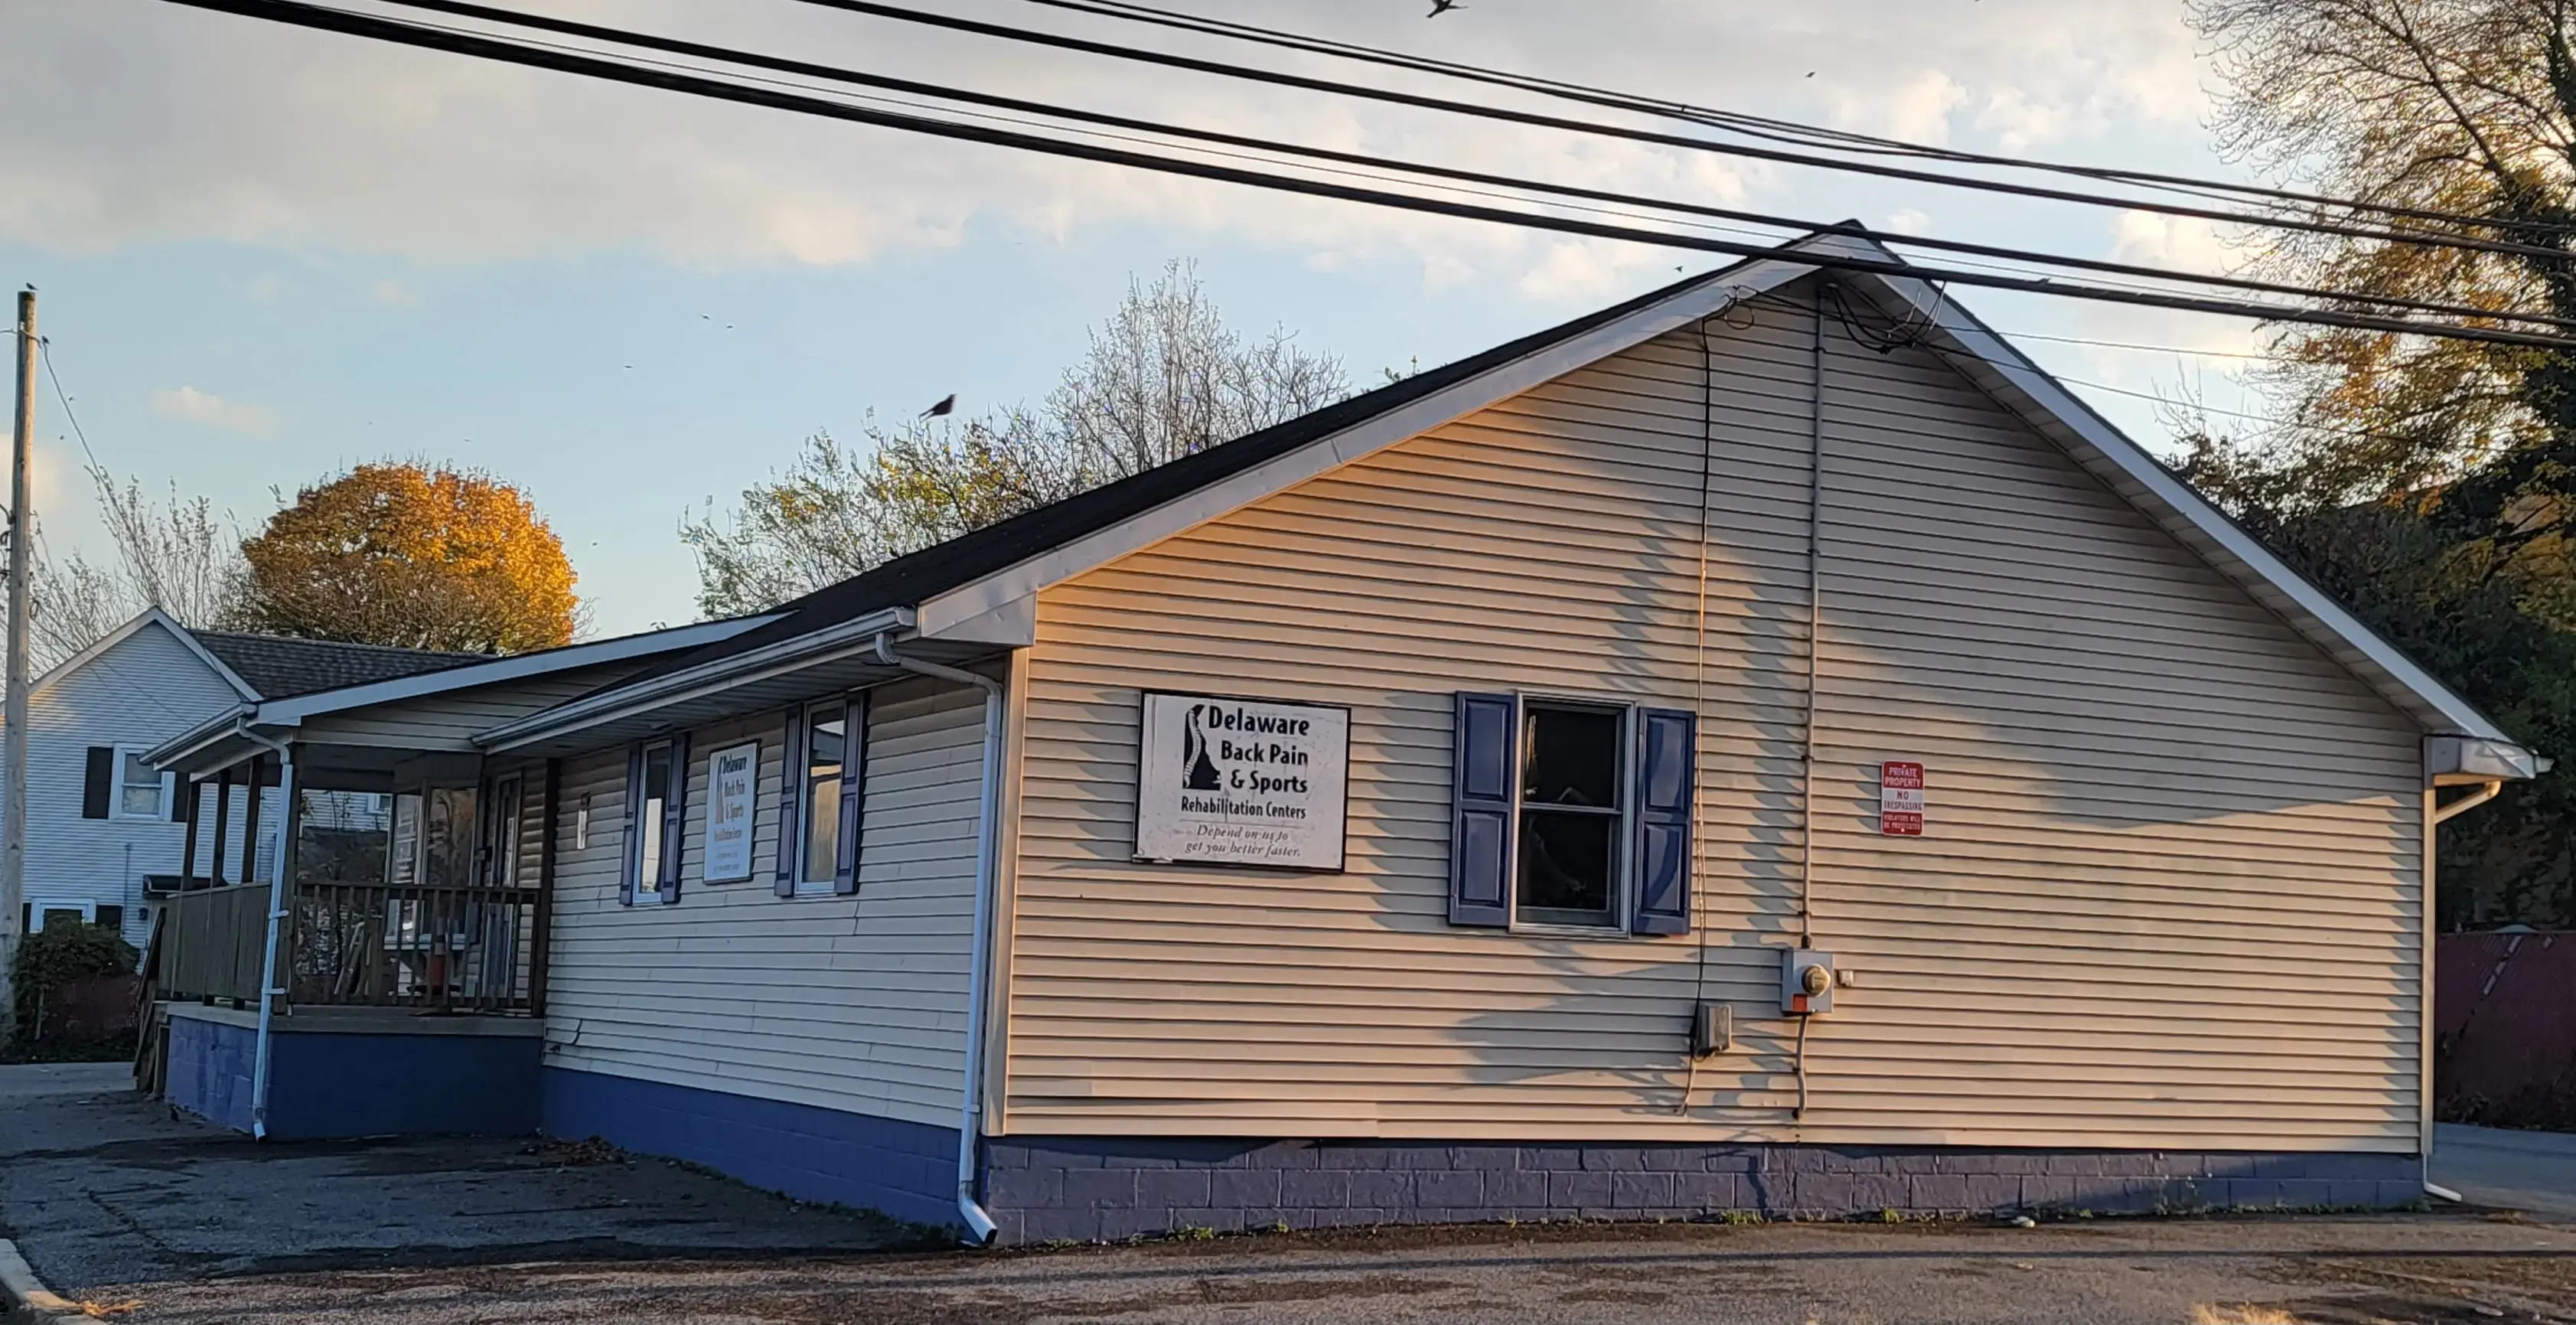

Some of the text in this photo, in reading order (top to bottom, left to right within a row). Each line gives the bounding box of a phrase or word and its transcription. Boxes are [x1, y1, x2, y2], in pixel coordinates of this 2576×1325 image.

[1208, 706, 1309, 736] Delaware
[1221, 740, 1309, 765] Back Pain
[1889, 767, 1917, 778] PRIVATE
[1231, 769, 1308, 795] & Sports
[1885, 776, 1921, 788] PROPERTY
[1897, 791, 1909, 800] NO
[1181, 796, 1306, 819] Rehabilitation Centers
[1883, 801, 1922, 811] TRESPASSING
[1197, 824, 1289, 842] Depend on us to
[1185, 842, 1300, 858] get you better faster.
